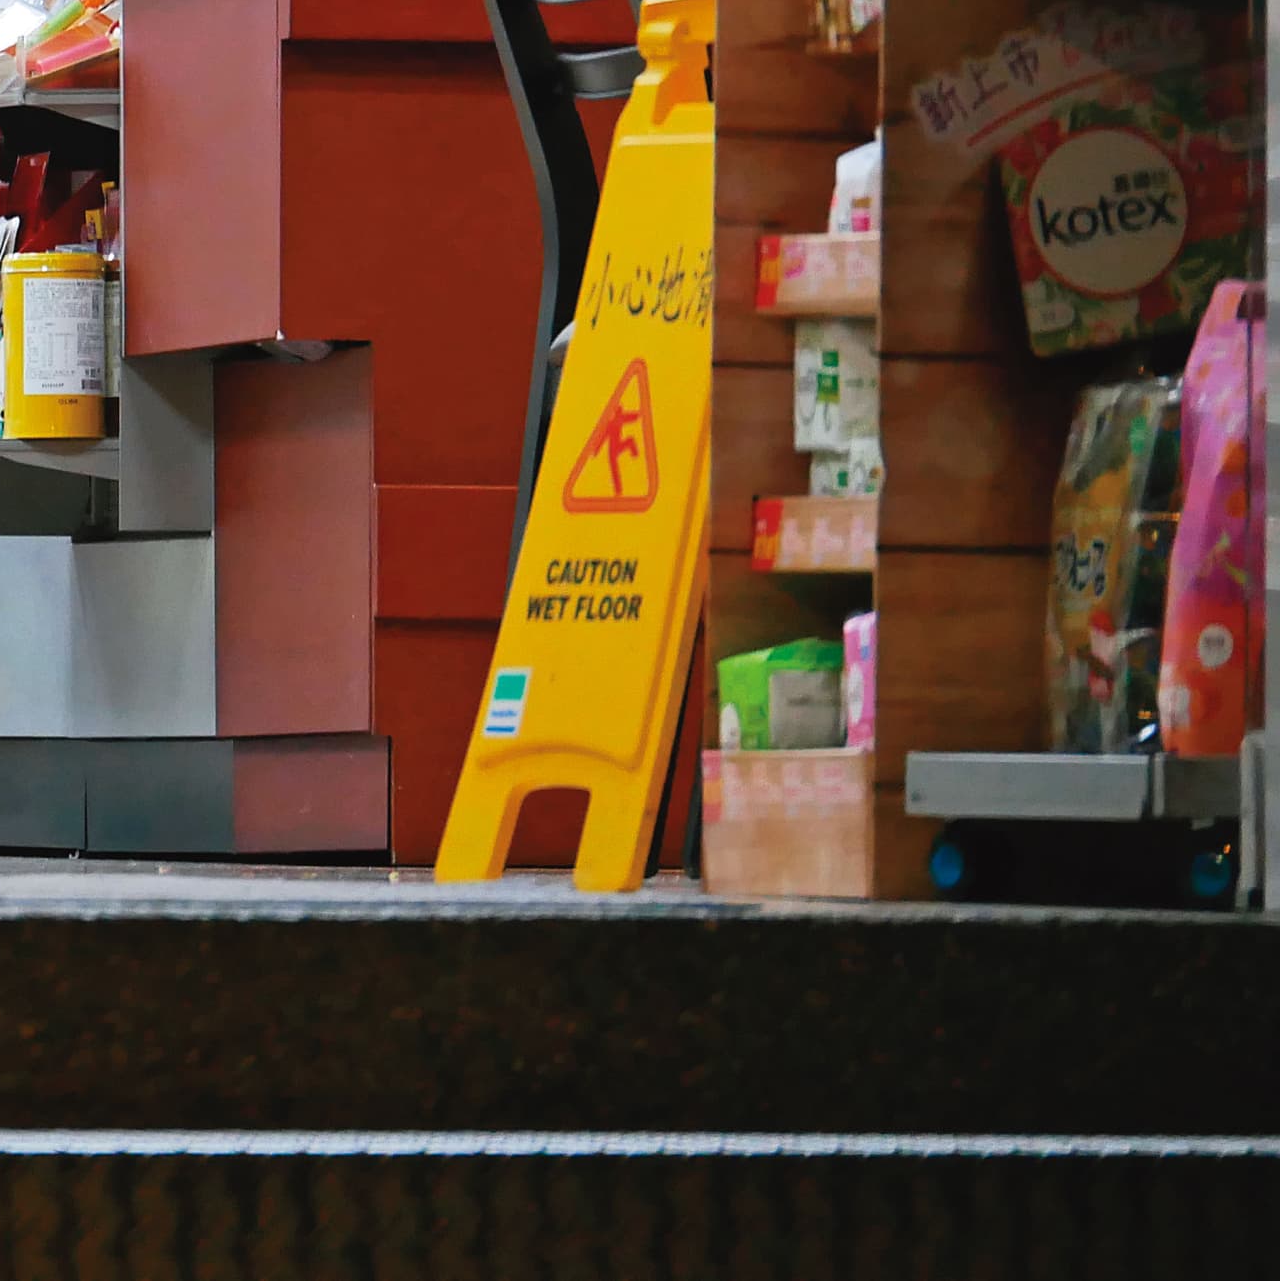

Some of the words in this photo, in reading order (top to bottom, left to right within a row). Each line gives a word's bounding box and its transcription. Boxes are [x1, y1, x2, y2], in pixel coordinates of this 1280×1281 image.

[1034, 192, 1177, 248] kotex
[546, 559, 638, 585] CAUTION
[527, 596, 570, 621] WET
[574, 595, 643, 622] FLOOR
